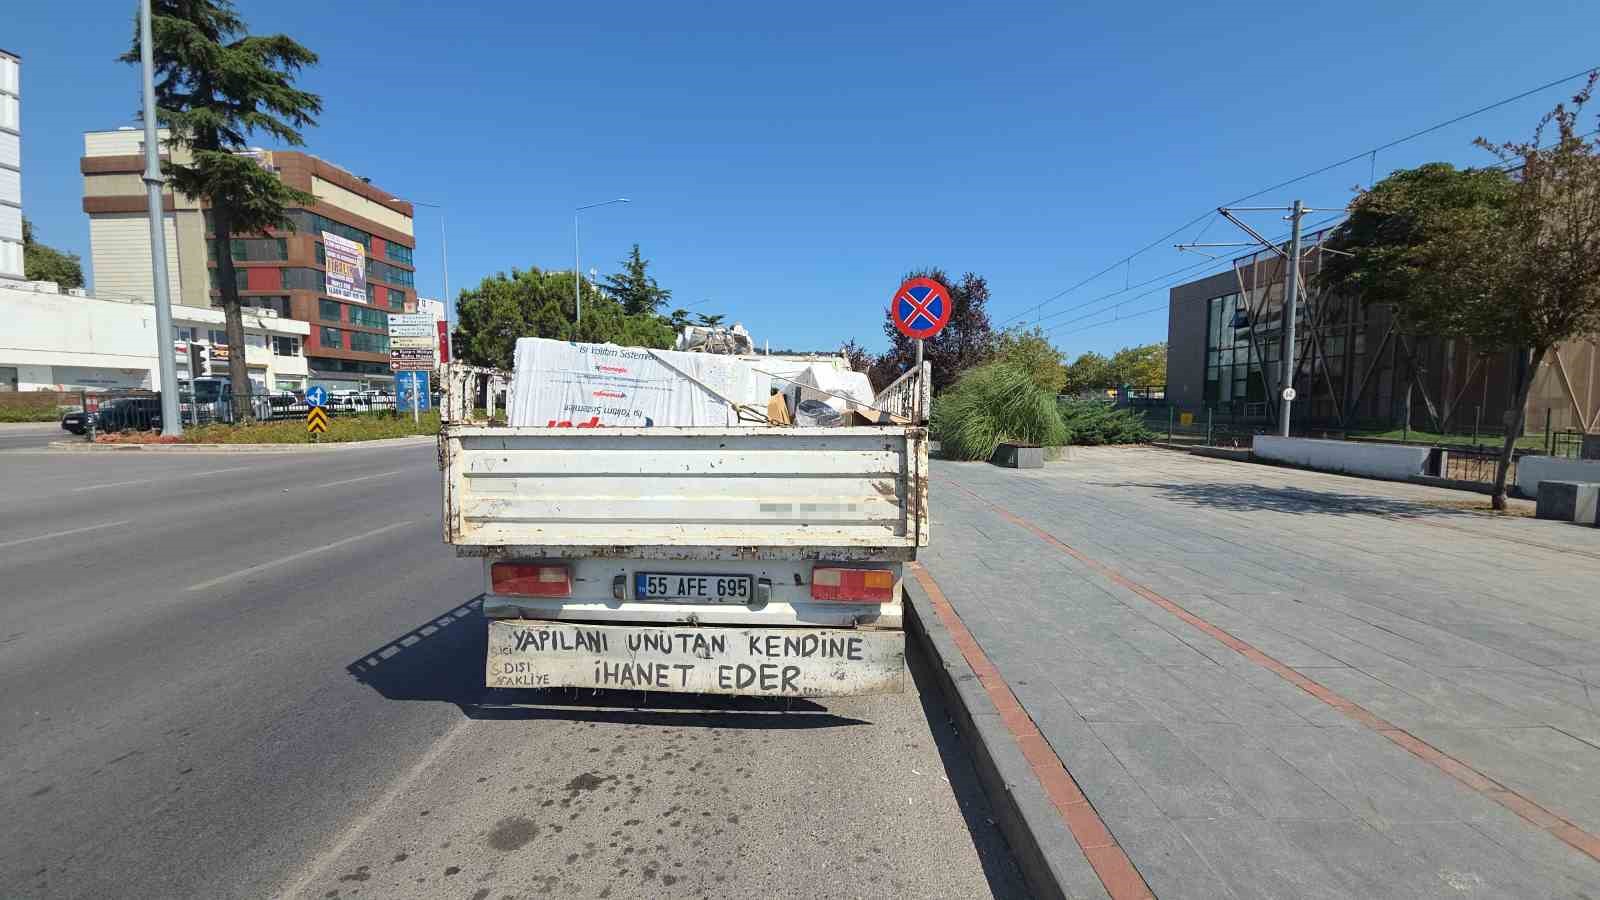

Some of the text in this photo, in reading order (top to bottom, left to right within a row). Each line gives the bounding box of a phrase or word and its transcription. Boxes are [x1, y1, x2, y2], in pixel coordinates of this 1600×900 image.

[648, 576, 668, 594] 55
[677, 578, 707, 597] AFE
[717, 578, 747, 597] 695
[513, 629, 607, 653] YAPILANI
[628, 633, 725, 654] UNUTAN
